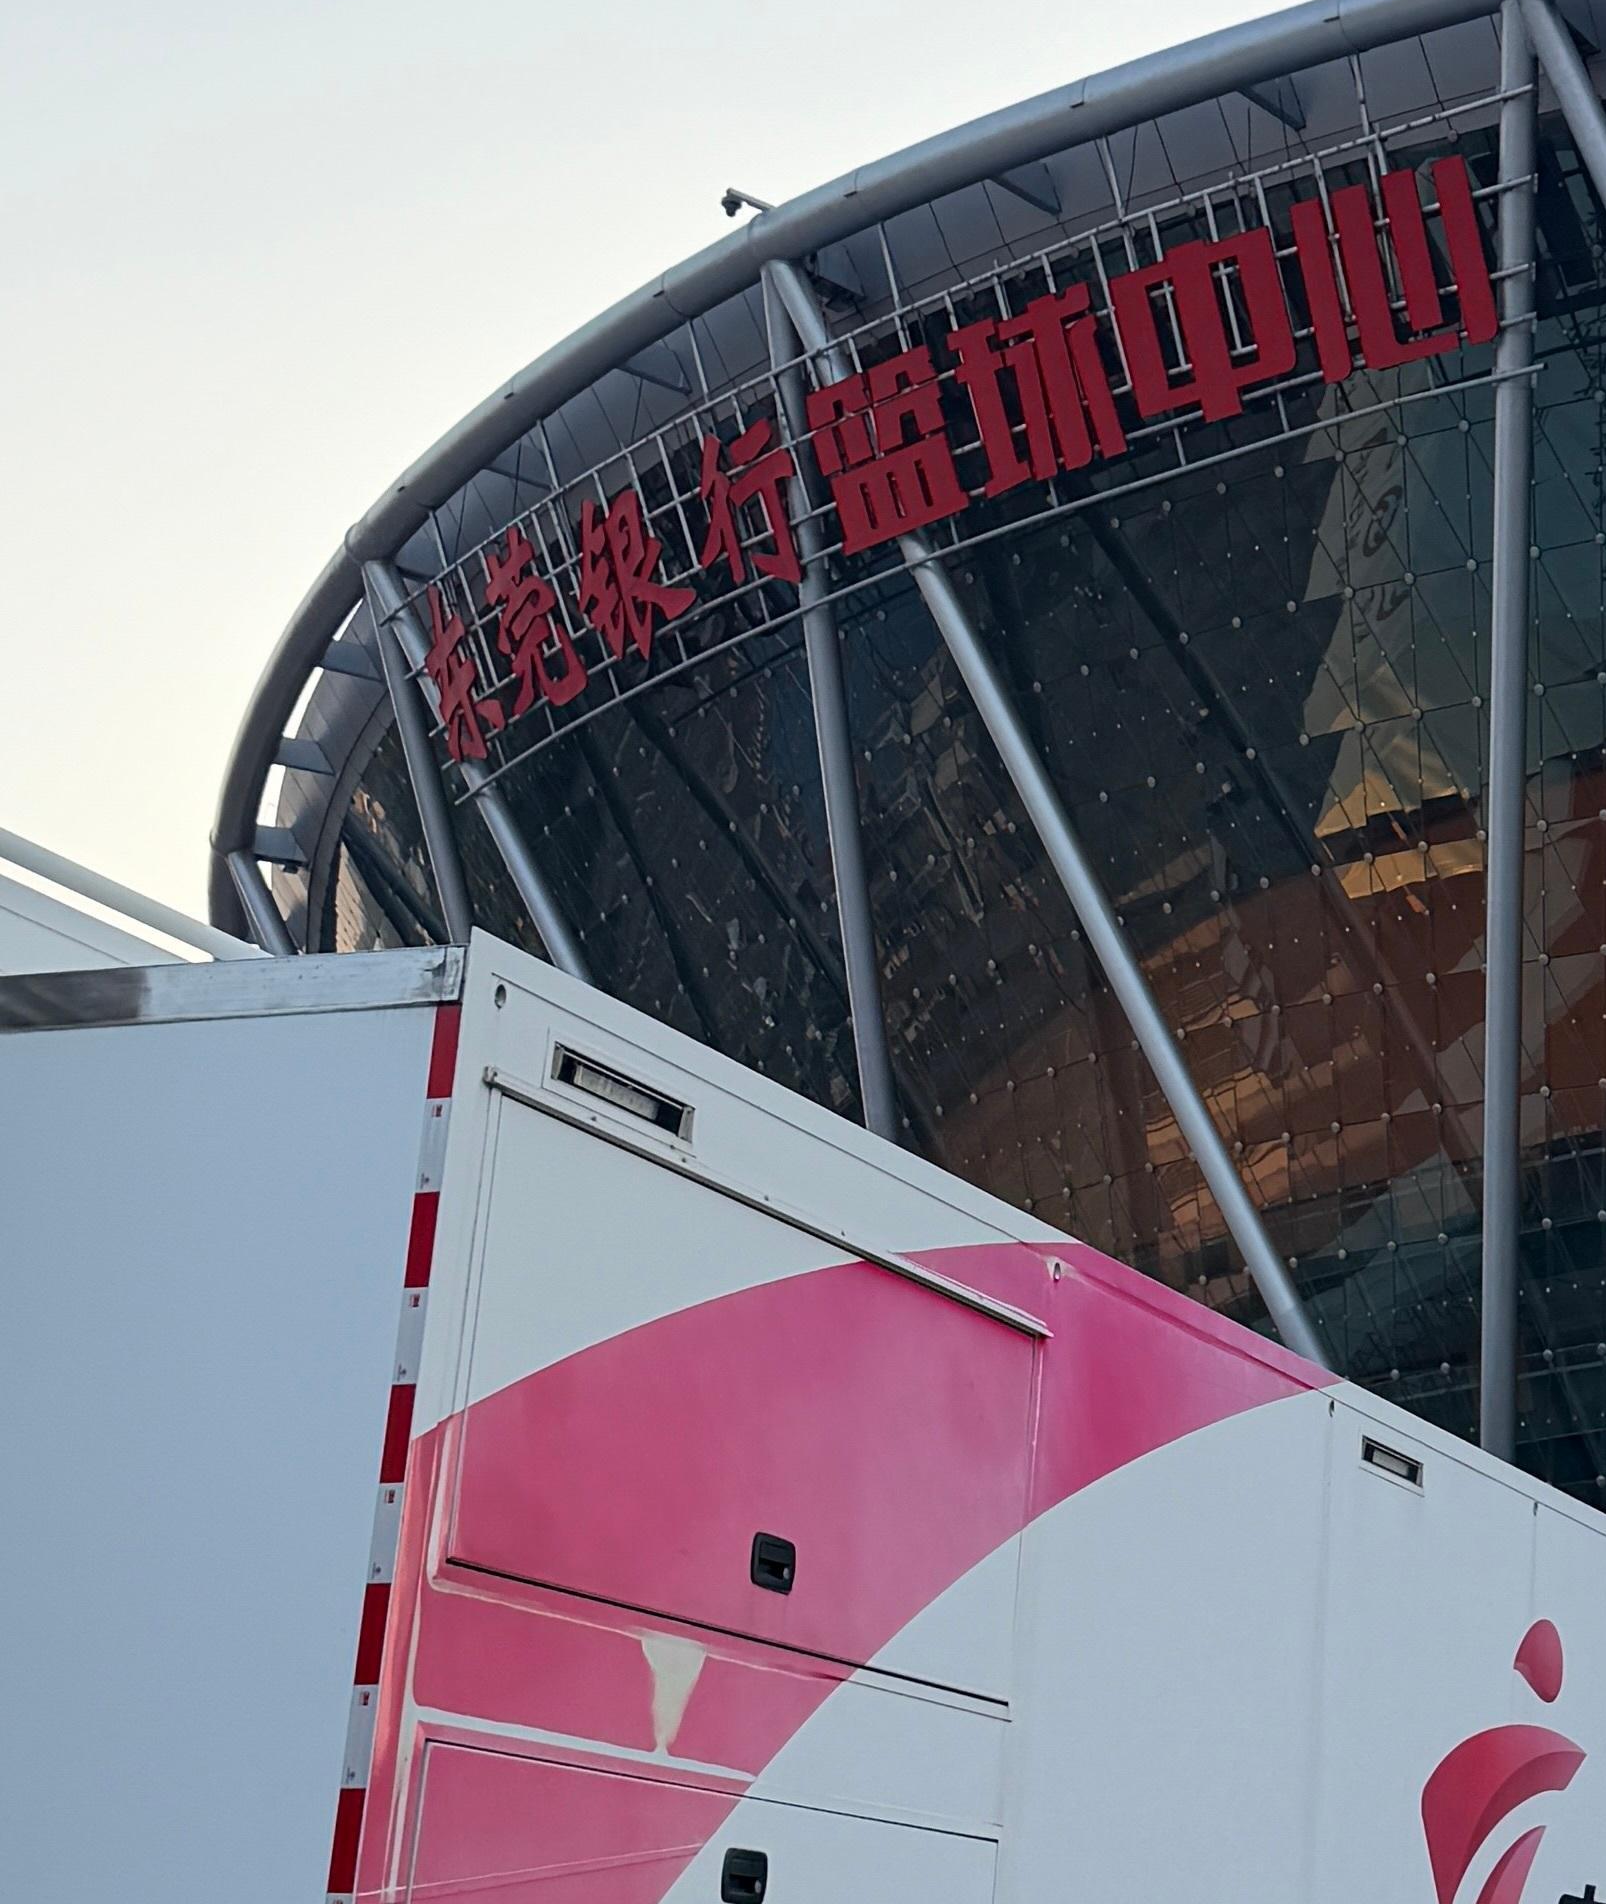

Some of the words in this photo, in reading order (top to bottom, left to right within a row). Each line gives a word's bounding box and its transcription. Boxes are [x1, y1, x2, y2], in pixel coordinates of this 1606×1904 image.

[427, 156, 1498, 759] 东莞银行篮球中心
